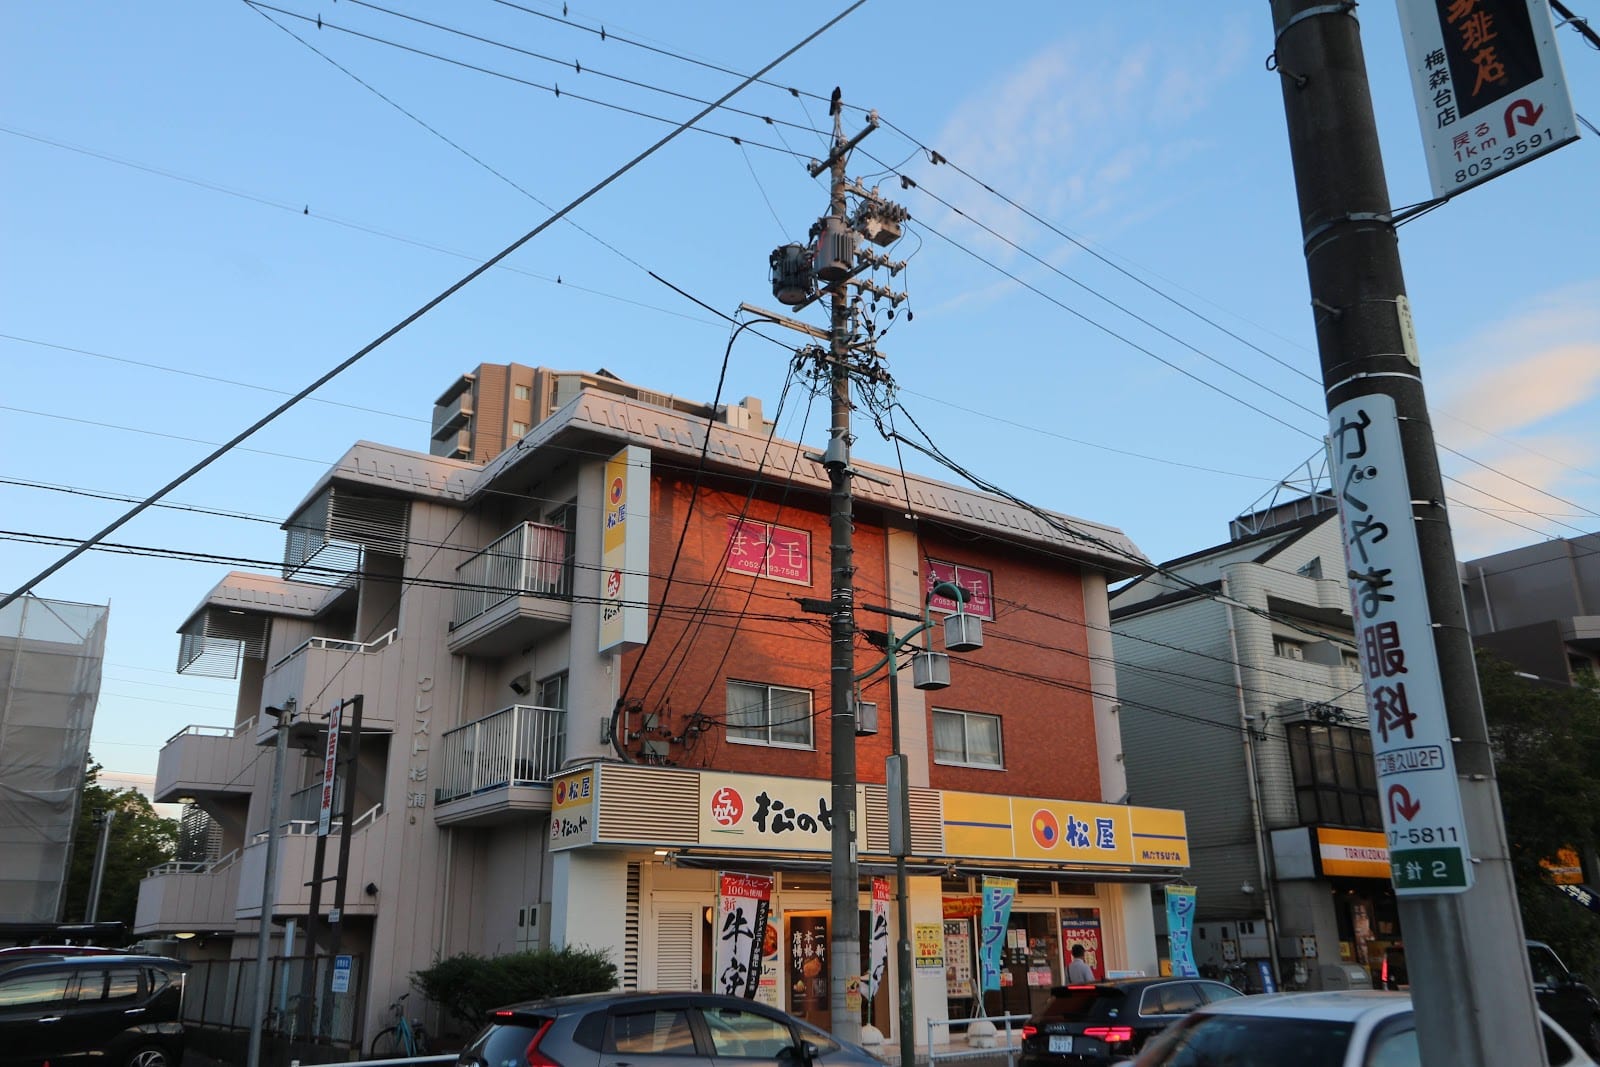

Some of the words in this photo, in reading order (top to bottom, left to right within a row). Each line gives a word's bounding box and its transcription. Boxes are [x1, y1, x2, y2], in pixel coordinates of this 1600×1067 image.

[1424, 47, 1456, 129] 梅森台店
[1452, 122, 1490, 150] 戻る
[1455, 128, 1553, 183] 803-3591
[607, 504, 625, 528] 松屋
[731, 531, 803, 569] まつ毛
[408, 672, 434, 810] クレスト杉浦
[568, 776, 590, 799] 松屋
[561, 815, 588, 837] 松のや
[1066, 815, 1116, 850] 松屋
[1389, 826, 1458, 846] 7-5811
[1142, 849, 1181, 861] MATSUYA
[1431, 860, 1448, 878] 2
[725, 877, 770, 888] アンガスビーフ
[724, 898, 737, 912] 新
